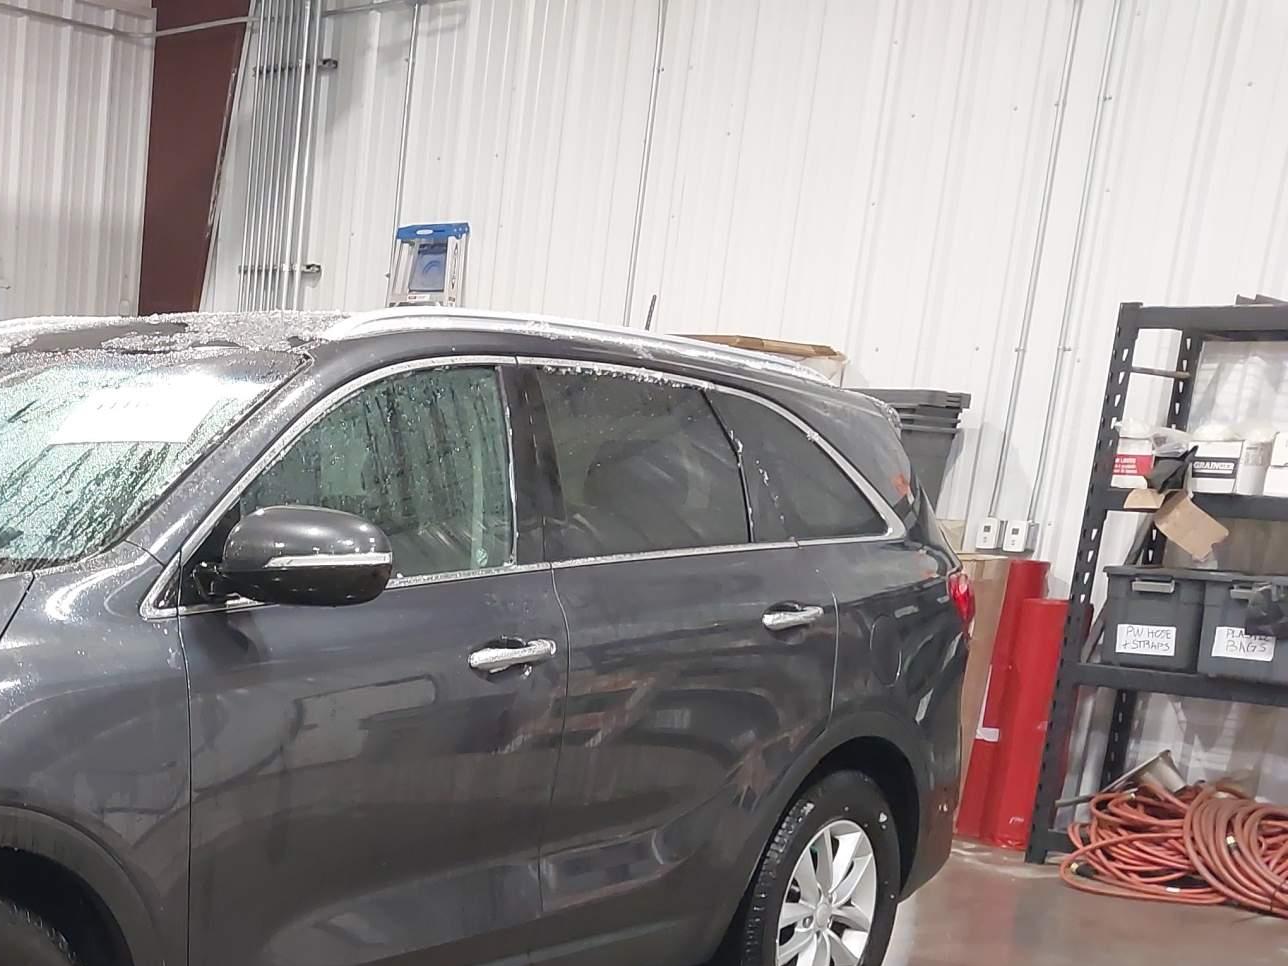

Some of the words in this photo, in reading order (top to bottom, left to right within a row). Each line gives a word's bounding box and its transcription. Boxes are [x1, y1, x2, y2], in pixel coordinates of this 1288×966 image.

[1126, 626, 1144, 638] PW
[1147, 627, 1172, 639] HOSE
[1226, 640, 1267, 653] BAGS
